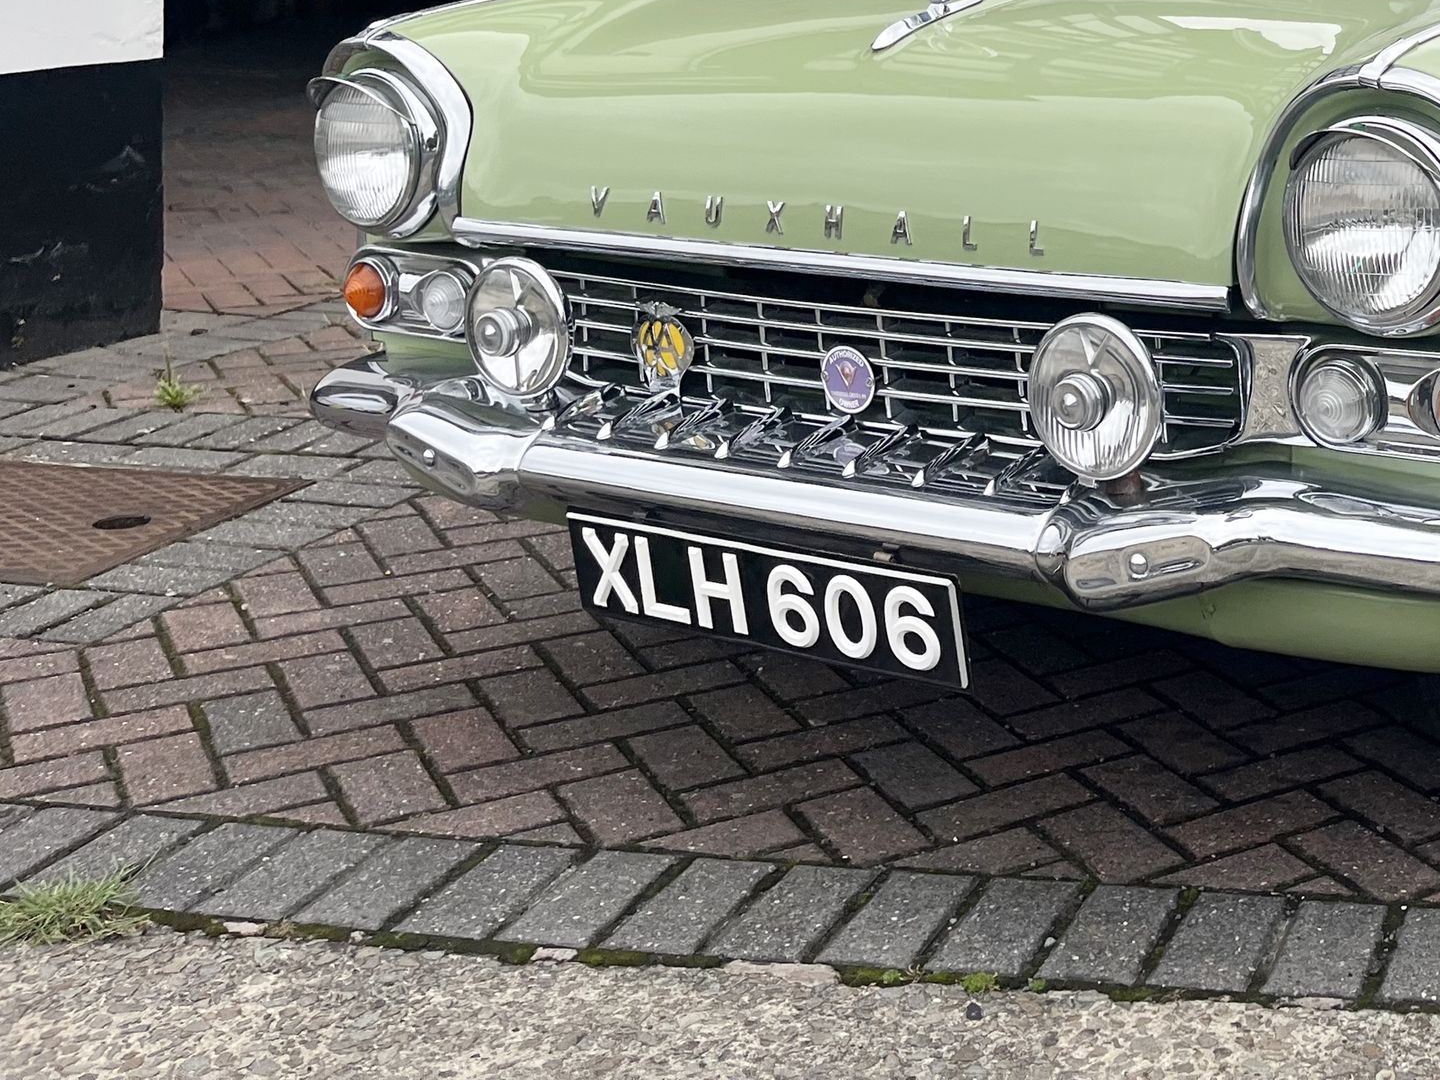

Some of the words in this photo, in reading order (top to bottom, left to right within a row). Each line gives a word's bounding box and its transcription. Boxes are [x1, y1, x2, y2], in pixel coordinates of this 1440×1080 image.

[590, 185, 1045, 257] VAUXHALL
[829, 350, 865, 368] AUTHORIZED
[838, 397, 860, 409] OWNER
[581, 526, 749, 636] XLH
[766, 564, 942, 672] 606
